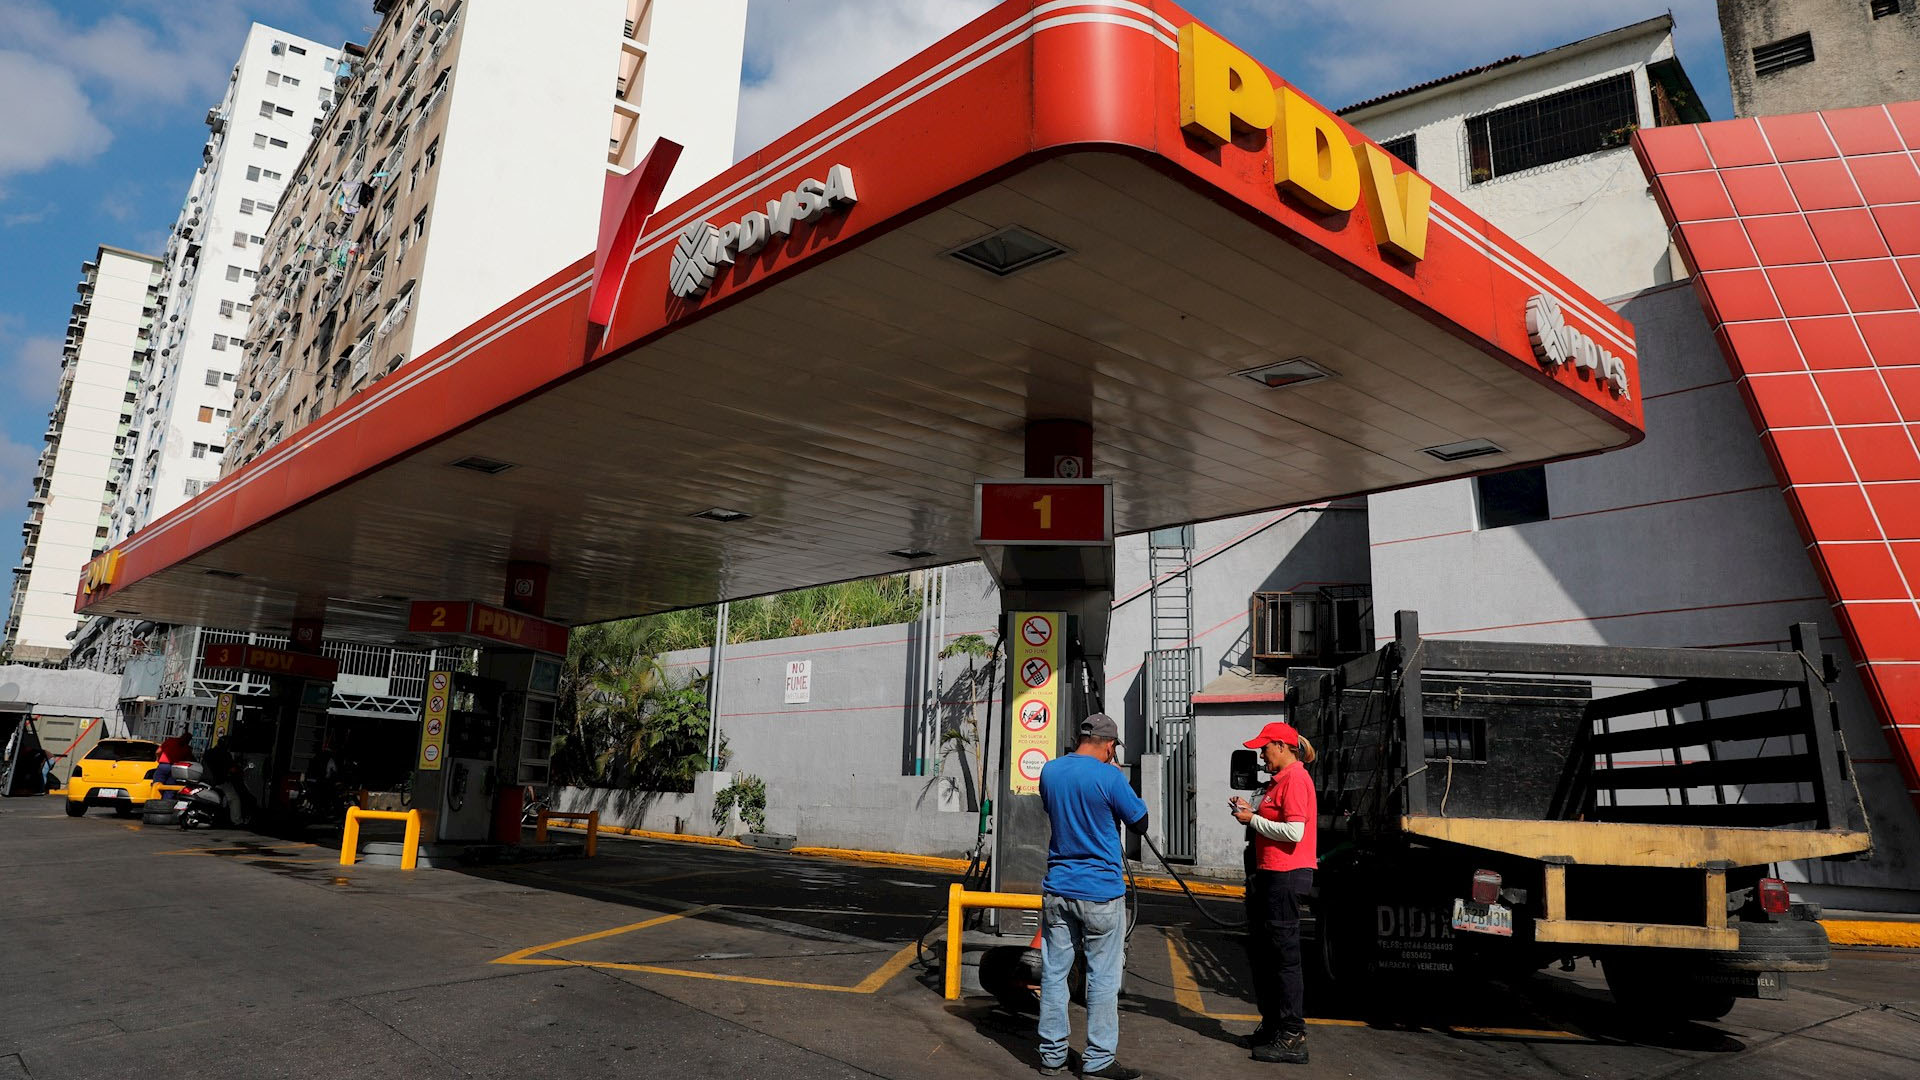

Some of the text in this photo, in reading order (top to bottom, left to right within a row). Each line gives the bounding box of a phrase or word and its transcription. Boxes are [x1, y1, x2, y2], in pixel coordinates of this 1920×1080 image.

[1178, 21, 1432, 263] PDV
[715, 163, 859, 265] PDVSA
[1032, 494, 1052, 529] 1
[83, 549, 120, 595] PDV
[430, 606, 526, 641] 2 PDV
[219, 648, 295, 670] 3 PDV
[792, 662, 805, 674] NO
[786, 675, 808, 691] FUME
[1417, 961, 1454, 971] VENEZUELA
